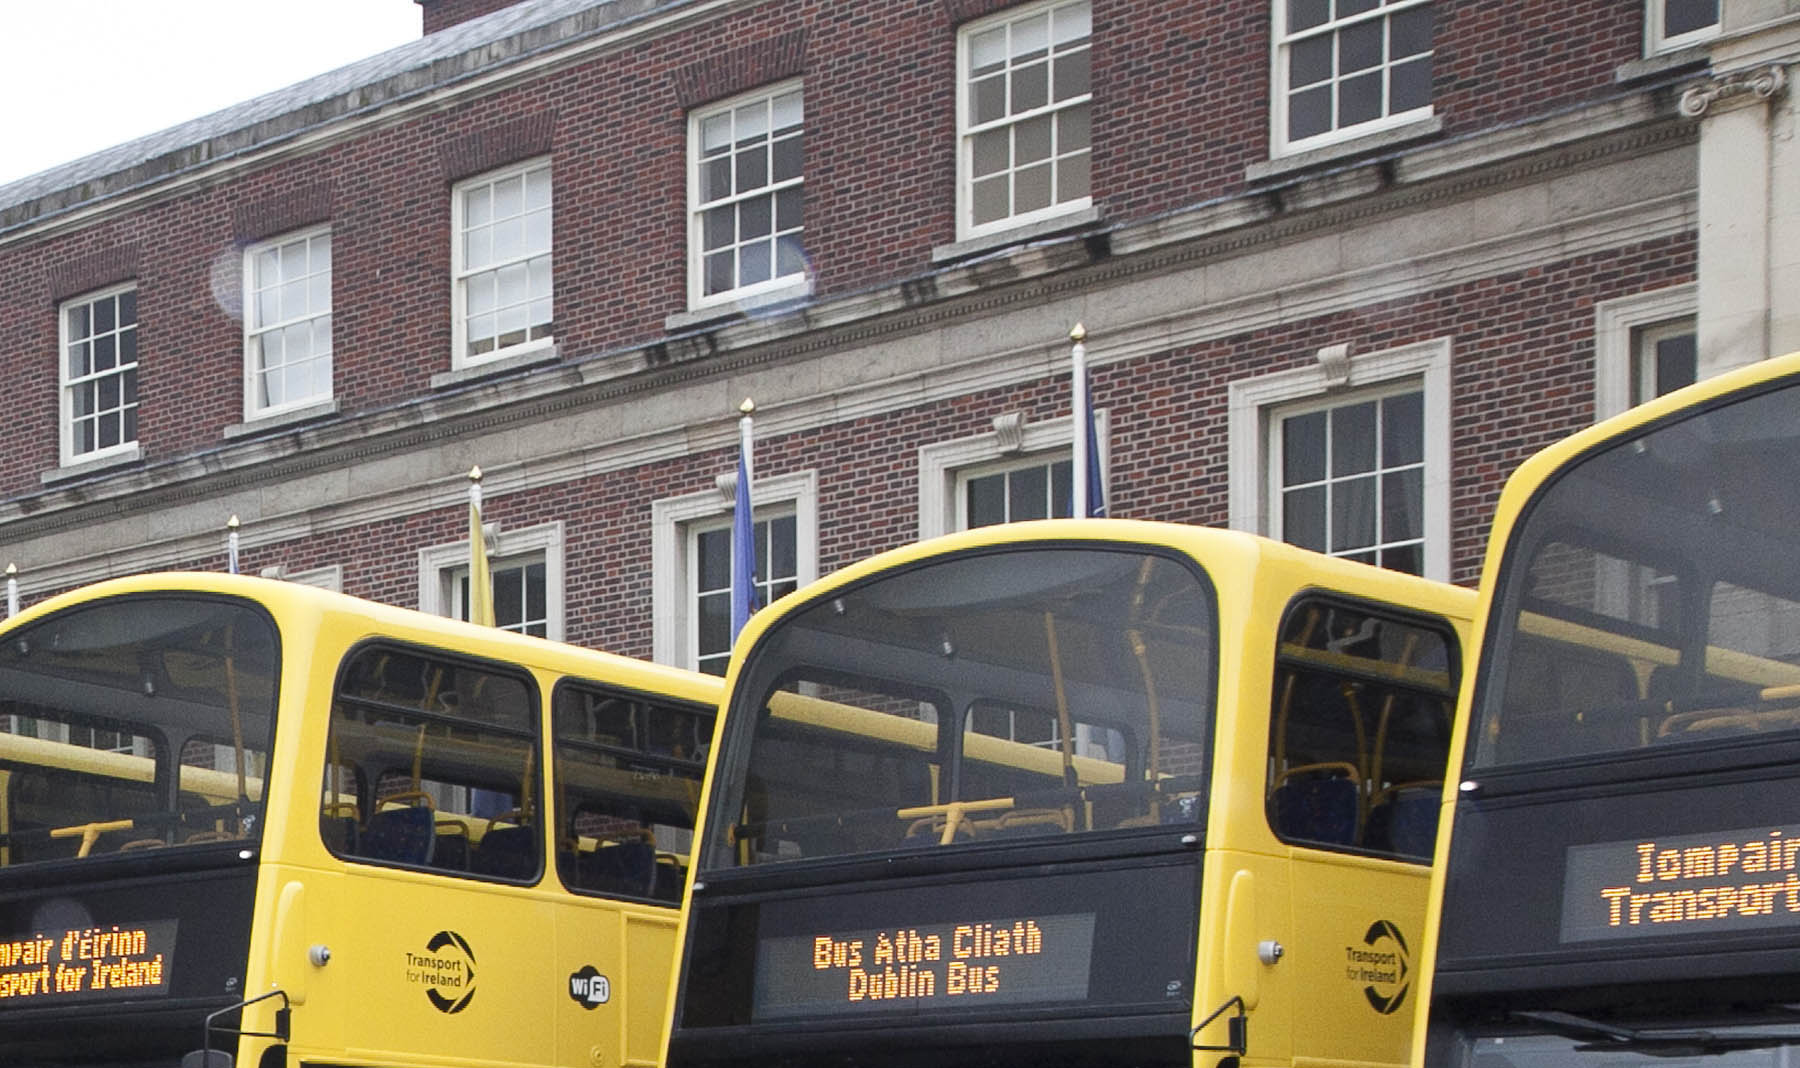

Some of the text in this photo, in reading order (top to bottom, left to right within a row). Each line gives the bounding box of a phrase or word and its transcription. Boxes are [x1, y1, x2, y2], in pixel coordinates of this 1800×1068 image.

[1601, 872, 1800, 926] Transport
[814, 936, 863, 969] Bus
[953, 920, 1042, 959] Cliath
[1345, 946, 1396, 965] Transport
[55, 962, 87, 992] for
[91, 954, 163, 990] Ireland
[406, 953, 462, 971] Transport
[1360, 966, 1397, 984] Ireland
[406, 970, 462, 987] for Ireland
[848, 962, 999, 1001] Dublin Bus
